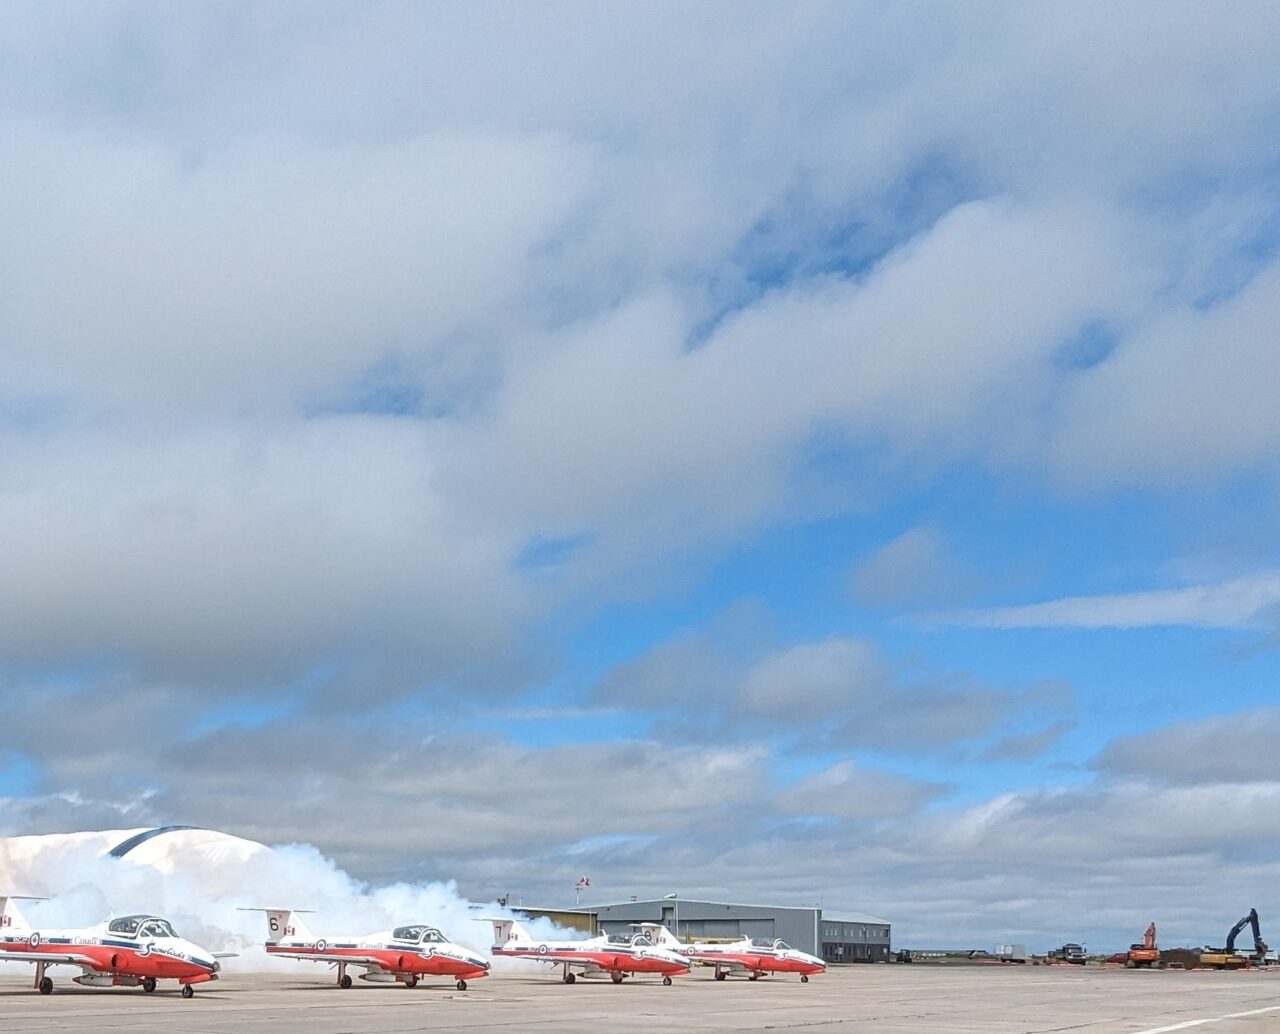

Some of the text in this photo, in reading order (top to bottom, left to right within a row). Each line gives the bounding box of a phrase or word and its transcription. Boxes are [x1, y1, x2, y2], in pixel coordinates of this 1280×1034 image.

[269, 916, 279, 932] 6
[495, 925, 502, 938] 7
[137, 940, 186, 960] Snowbirds
